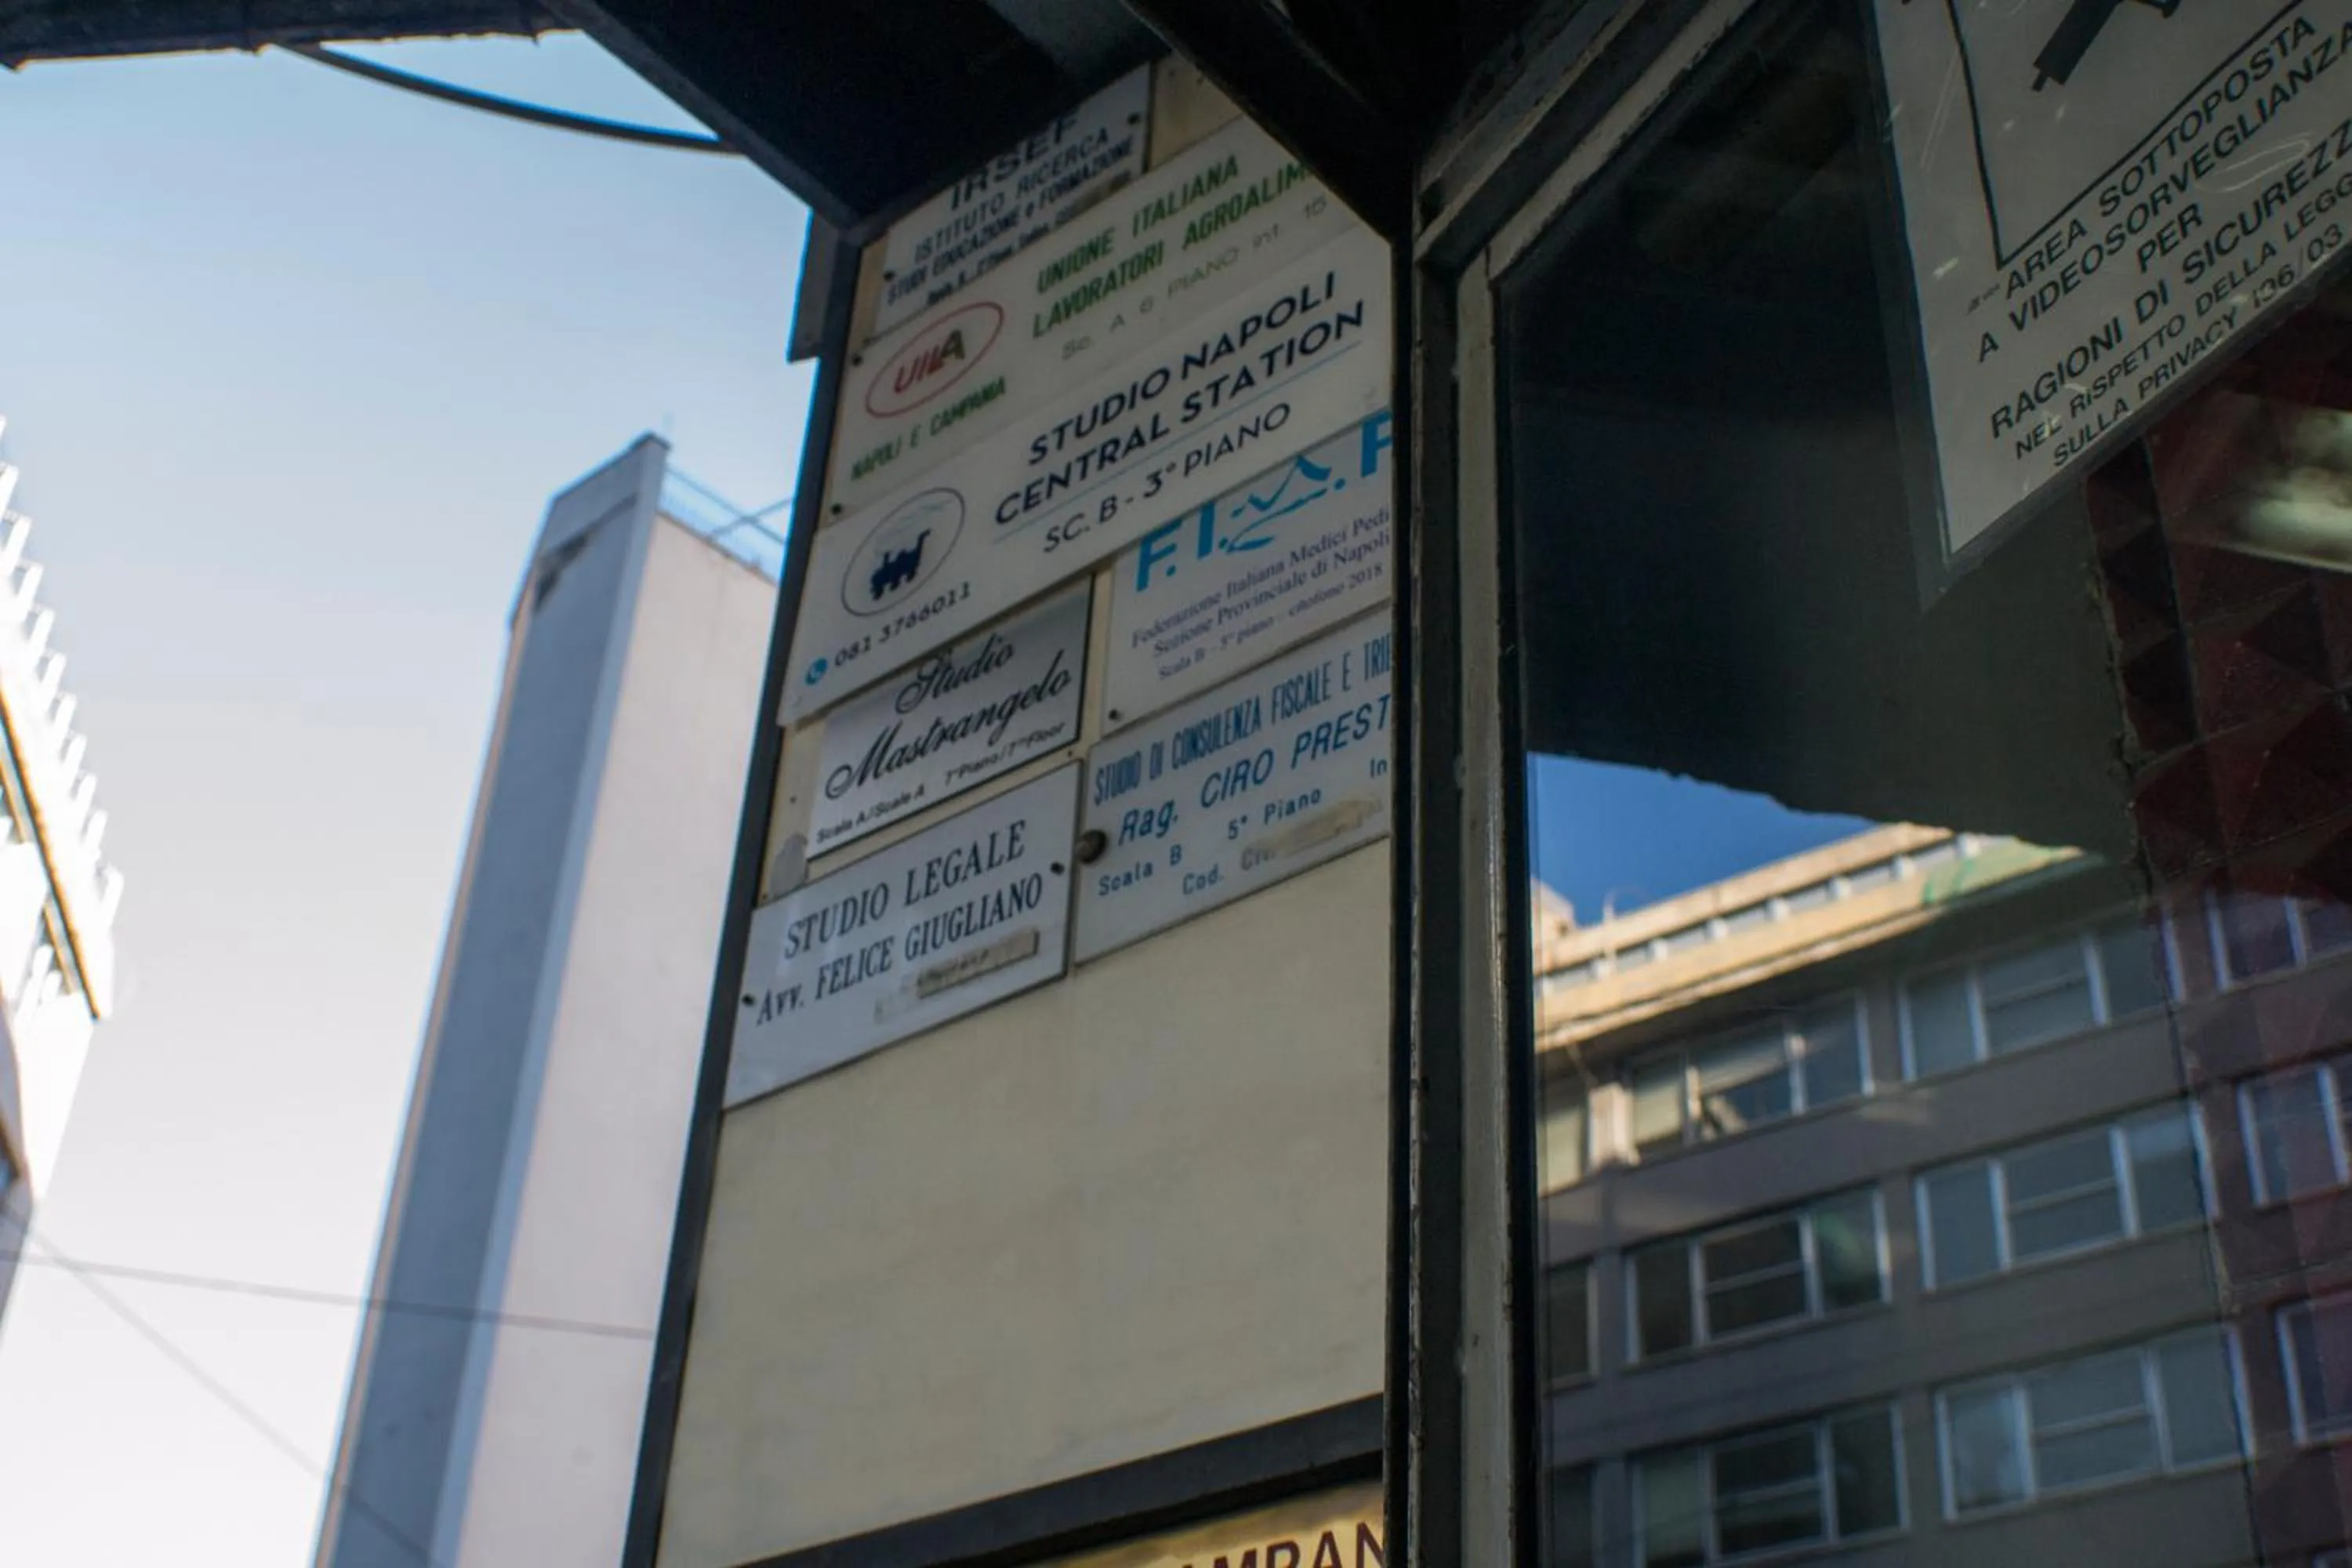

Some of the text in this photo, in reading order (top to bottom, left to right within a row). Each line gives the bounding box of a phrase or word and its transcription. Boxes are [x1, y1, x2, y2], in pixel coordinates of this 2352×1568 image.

[915, 192, 1004, 263] ISTITUTO
[1017, 128, 1108, 197] RICERCA
[2004, 14, 2317, 299] AREA SOTTOPOSTA
[1036, 227, 1116, 294] UNIONE
[1132, 154, 1239, 238] ITALIANA
[1168, 246, 1239, 298] PIANO
[2136, 203, 2203, 274] PER
[1033, 241, 1164, 338] LAVORATORI
[1977, 331, 2000, 363] A
[2015, 415, 2063, 459] NEL
[2069, 314, 2187, 419] RISPETTO
[2194, 241, 2278, 318] DELLA
[930, 376, 1006, 436] CAMPANIA
[995, 300, 1363, 524] CENTRAL STATION
[1029, 271, 1334, 464] STUDIO NAPOLI
[1991, 315, 2123, 439] RAGIONI
[2133, 279, 2170, 325] DI
[2053, 397, 2129, 468] SULLA
[2138, 305, 2237, 399] PRIVACY
[1044, 515, 1090, 553] SC.
[1099, 490, 1118, 524] B
[1184, 402, 1290, 477] PIANO
[834, 635, 872, 666] 081
[1132, 593, 1222, 648] Federazione
[1227, 561, 1284, 599] Italiana
[1290, 530, 1346, 567] Medici
[1153, 528, 1389, 654] Sezione Provinciale di Napoli
[1159, 655, 1191, 681] Scala
[1237, 616, 1274, 644] piano
[825, 649, 1071, 800] Mastrangelo
[895, 633, 1014, 713] Studio
[1094, 751, 1141, 806] STUDIO
[1150, 740, 1164, 780] DI
[1172, 695, 1261, 769] CONSULENZA
[1272, 662, 1331, 725] FISCALE
[1341, 652, 1352, 691] E
[1098, 861, 1152, 896] Scala
[1170, 844, 1181, 866] B
[1264, 789, 1321, 825] Piano
[1118, 800, 1178, 847] Rag.
[1200, 748, 1273, 809] CIRO
[785, 819, 1025, 959] STUDIO LEGALE
[815, 936, 894, 1001] FELICE
[905, 872, 1043, 961] GIUGLIANO
[1182, 865, 1223, 895] Cod.
